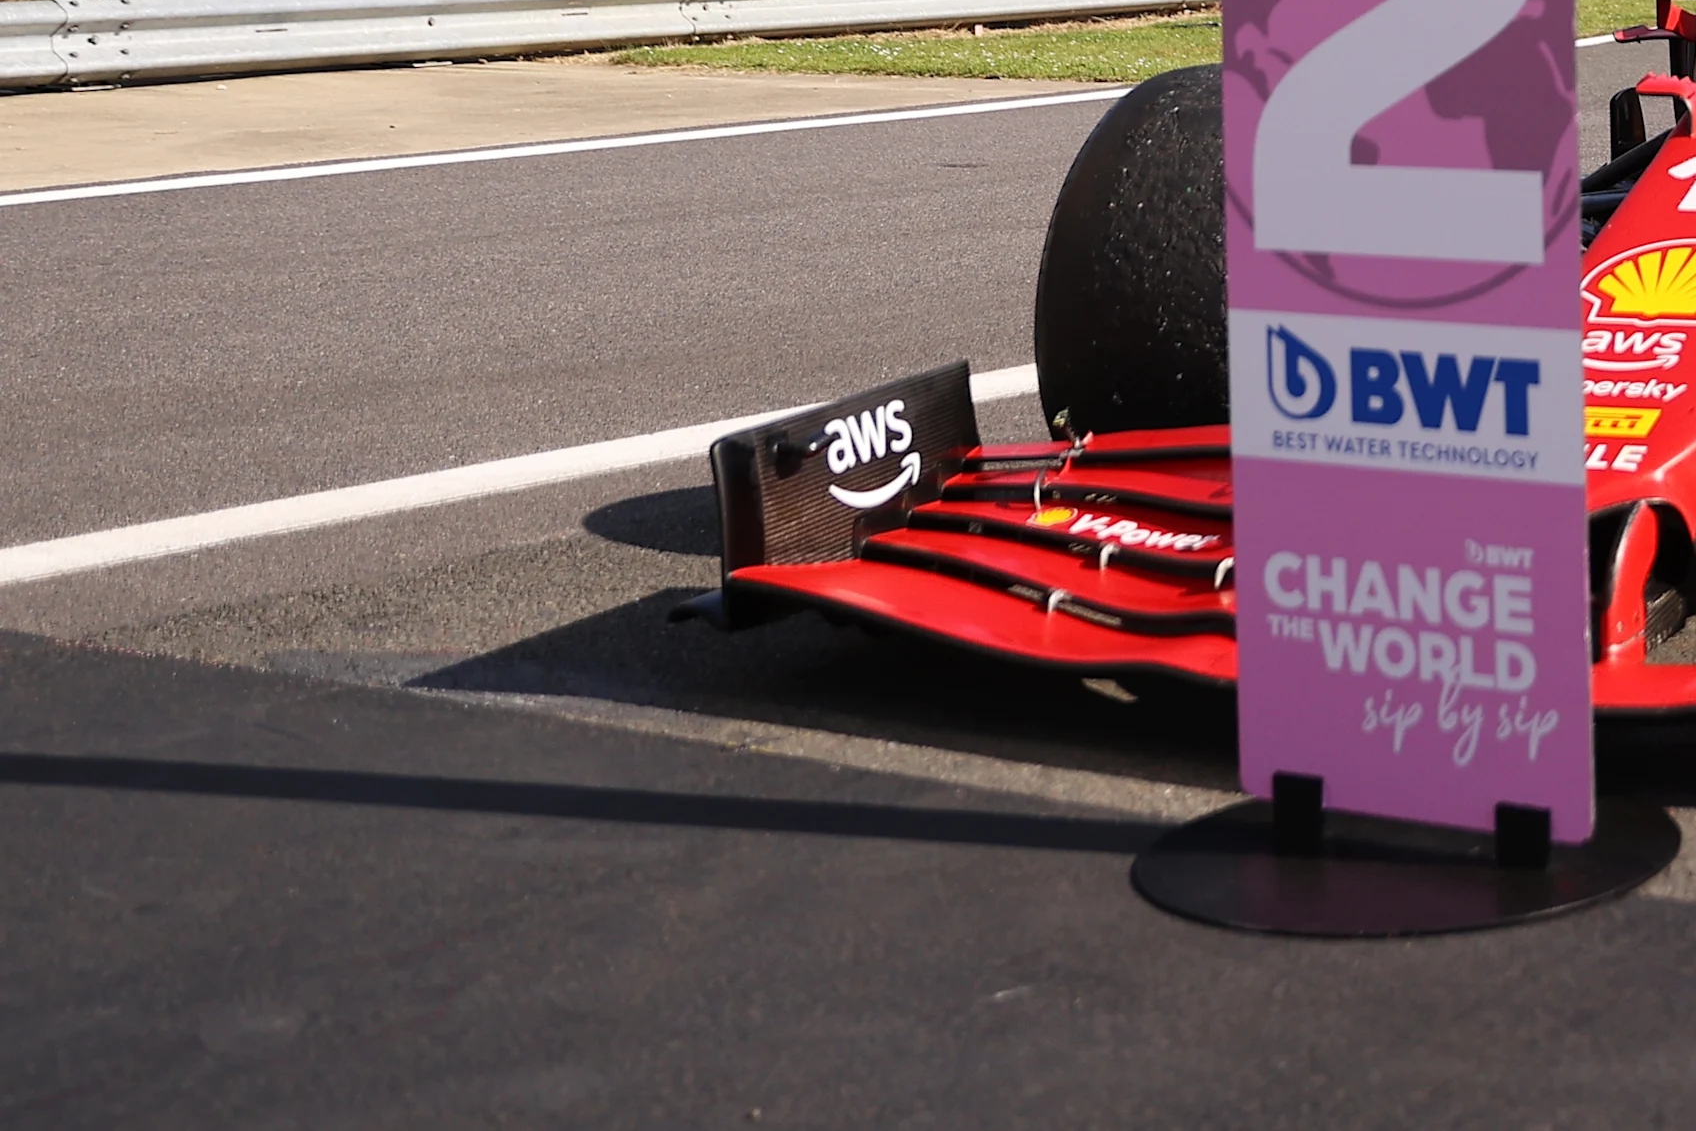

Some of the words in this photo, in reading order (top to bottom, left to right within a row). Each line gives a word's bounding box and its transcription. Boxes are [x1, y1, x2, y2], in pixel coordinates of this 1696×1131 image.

[1582, 329, 1687, 355] aws
[1350, 346, 1541, 437] BWT
[823, 398, 913, 475] aws
[1272, 429, 1318, 451] BEST
[1324, 435, 1392, 458] WATER
[1397, 440, 1539, 469] TECHNOLOGY
[1067, 512, 1222, 551] V-Power
[1485, 544, 1535, 568] BWT
[1263, 550, 1535, 636] CHANGE
[1266, 613, 1315, 642] THE
[1317, 618, 1537, 692] WORLD
[1361, 688, 1424, 754] sip
[1437, 665, 1484, 767] by
[1496, 694, 1559, 762] sip
